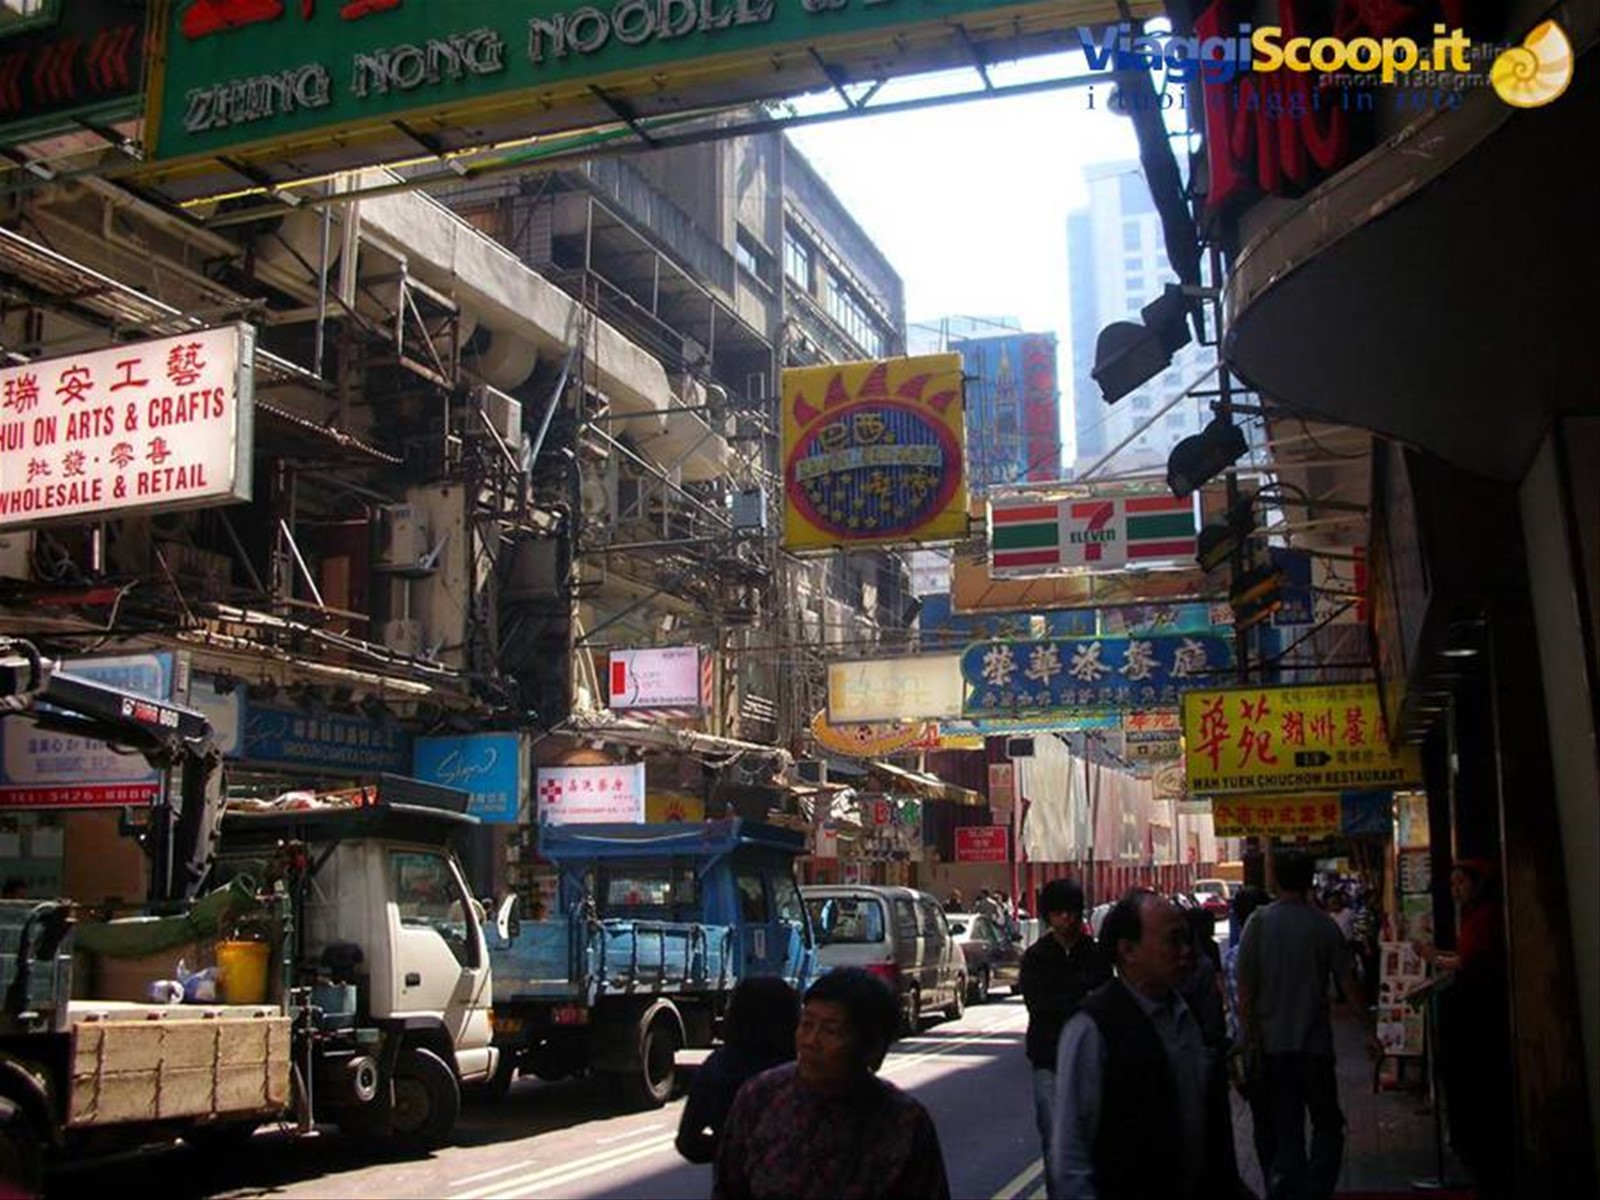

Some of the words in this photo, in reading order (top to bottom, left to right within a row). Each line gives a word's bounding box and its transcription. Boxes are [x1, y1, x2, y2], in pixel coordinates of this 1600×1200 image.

[350, 27, 505, 98] NONG
[526, 0, 777, 62] NOODLE
[3, 342, 206, 414] 瑞安工藝
[33, 415, 57, 447] ON
[66, 405, 114, 441] ARTS
[125, 402, 138, 432] &
[148, 387, 225, 428] CRAFTS
[113, 475, 126, 499] &
[138, 463, 207, 496] RETAIL
[1071, 499, 1114, 561] 7
